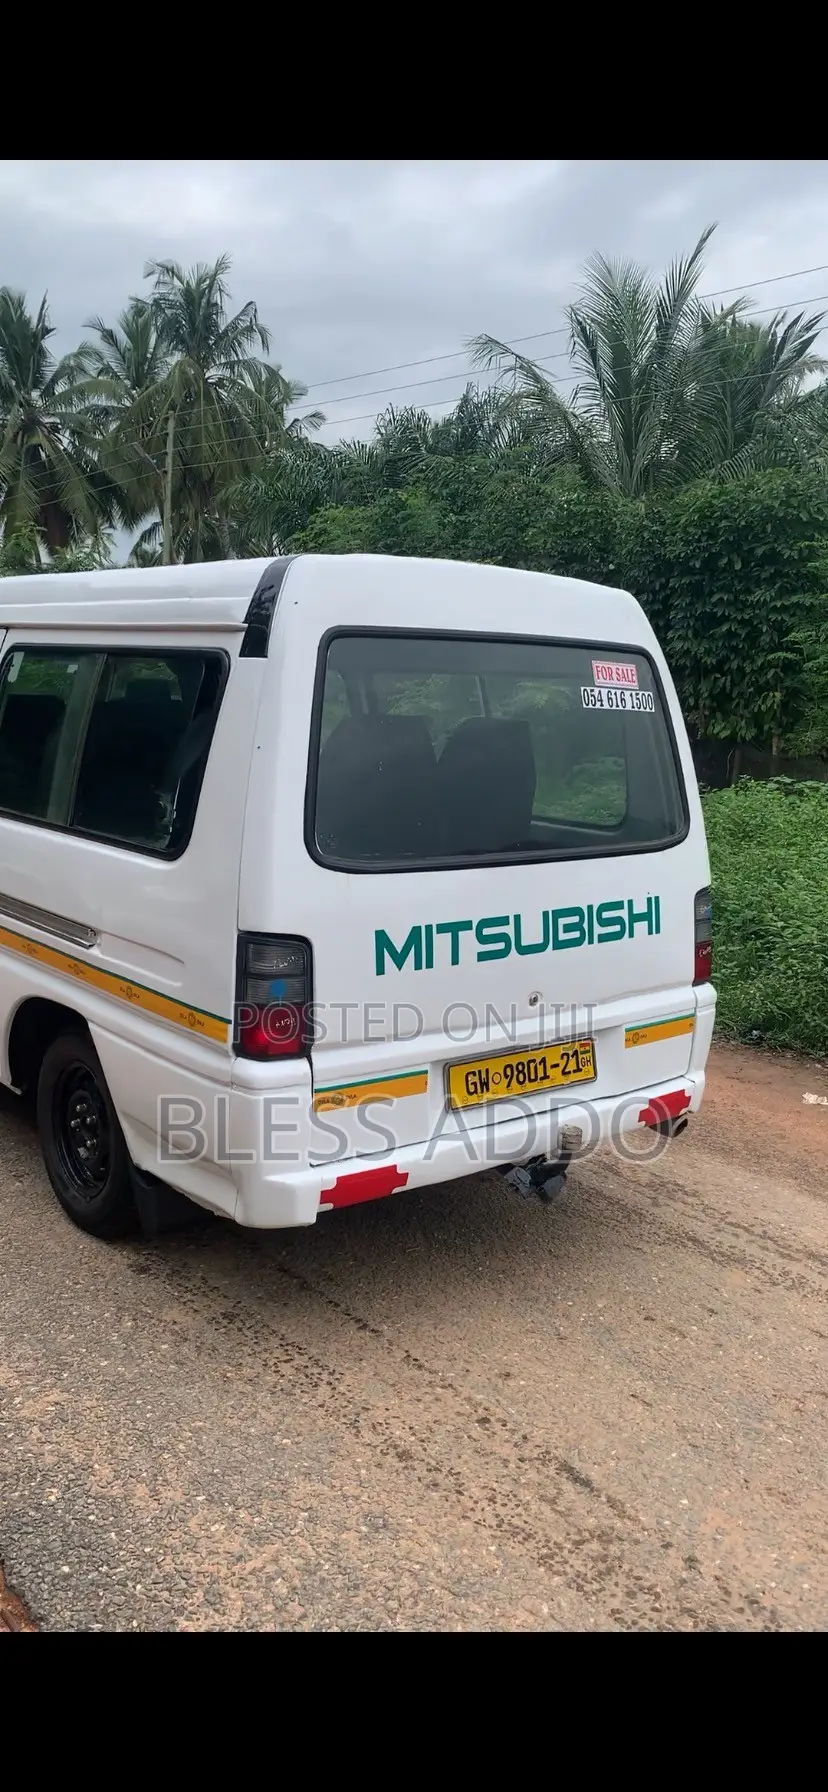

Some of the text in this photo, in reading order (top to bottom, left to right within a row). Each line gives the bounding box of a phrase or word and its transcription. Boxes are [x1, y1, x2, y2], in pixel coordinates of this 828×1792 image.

[595, 665, 636, 683] FOR SALE
[583, 688, 653, 711] 054 616 1500
[374, 895, 661, 976] MITSUBISHI
[464, 1068, 490, 1096] GW
[580, 1056, 592, 1067] GH
